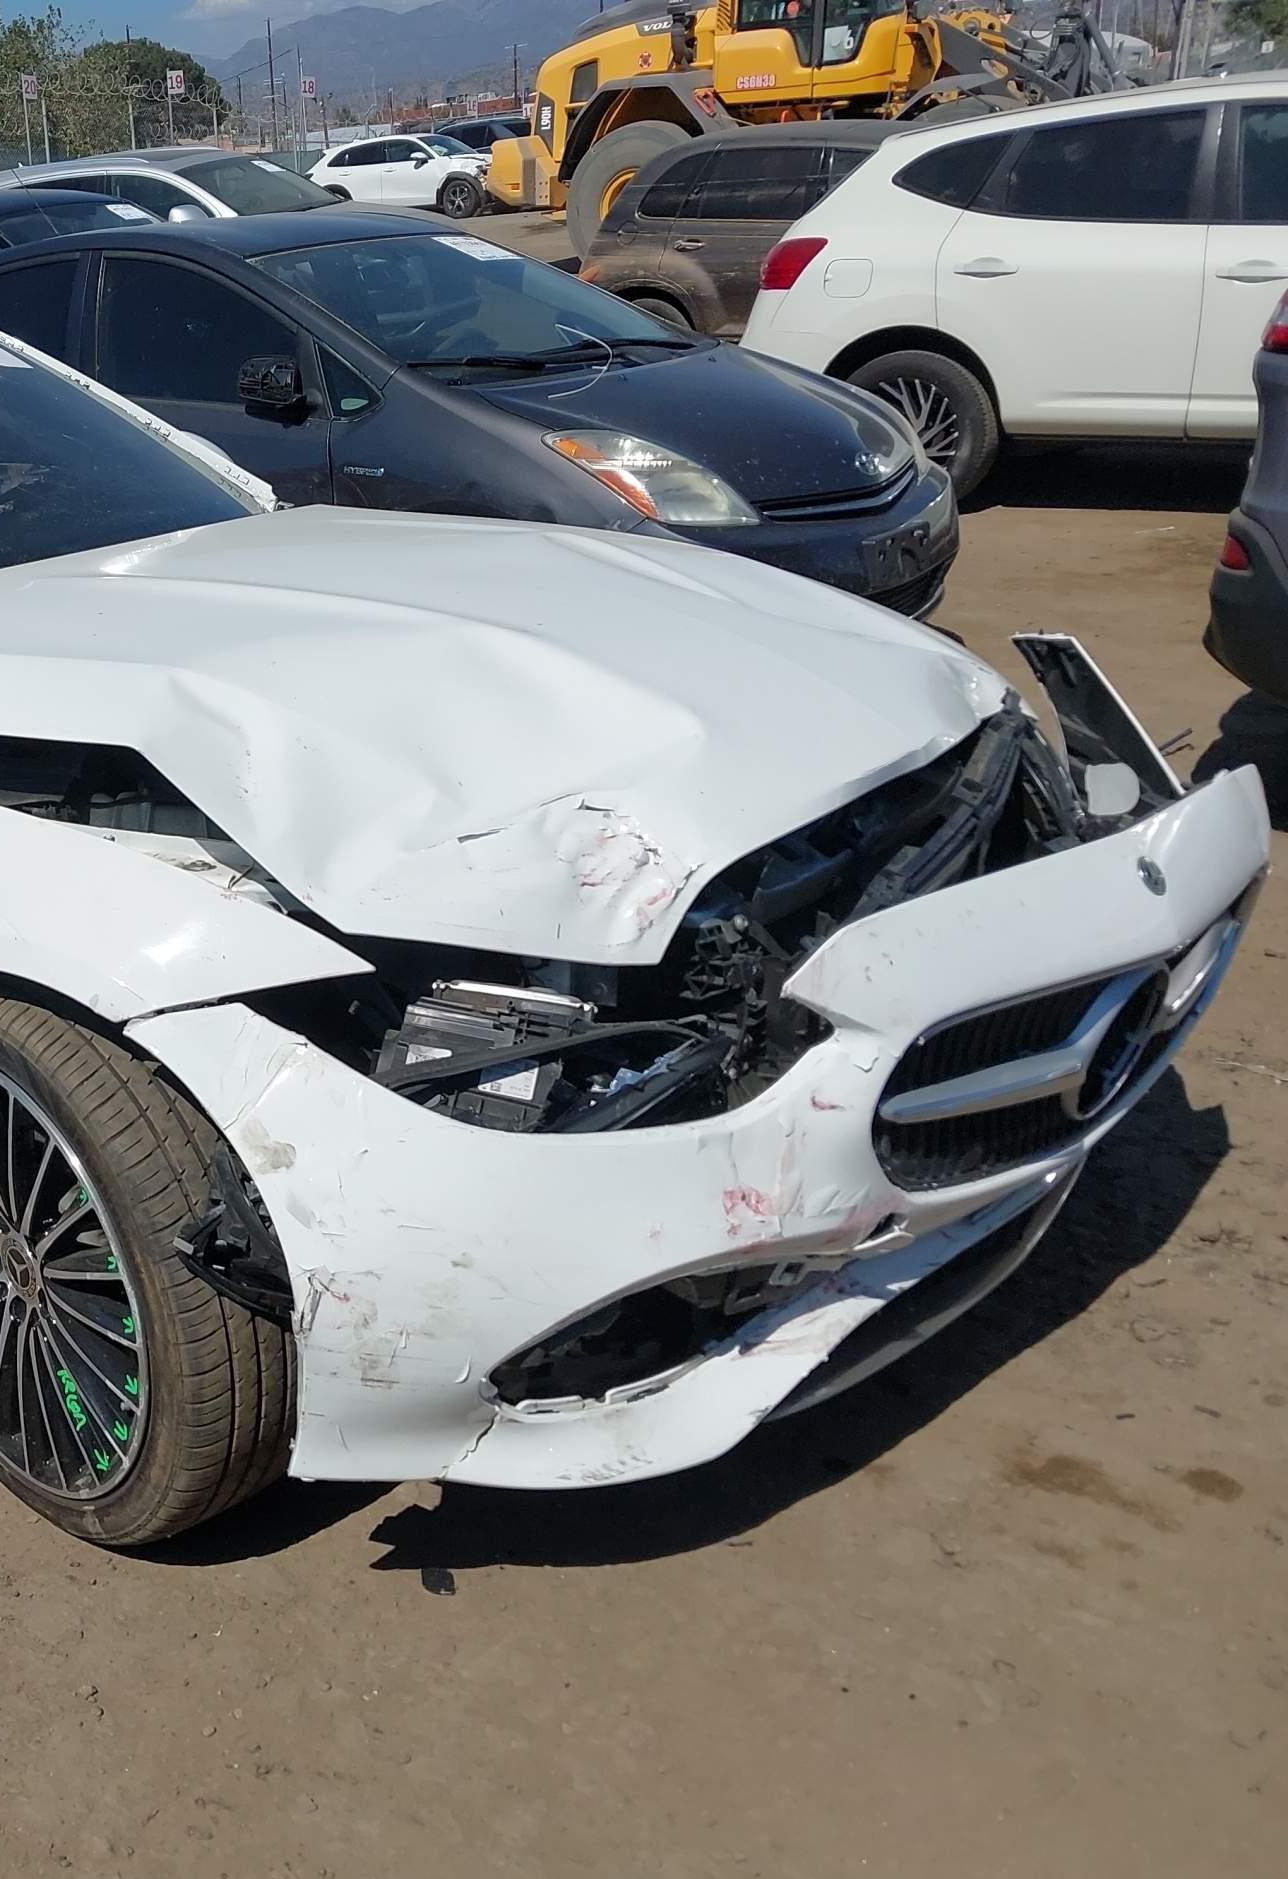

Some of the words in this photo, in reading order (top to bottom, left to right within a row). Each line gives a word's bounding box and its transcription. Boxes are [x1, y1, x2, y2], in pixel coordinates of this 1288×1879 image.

[24, 79, 36, 95] 20
[168, 74, 183, 90] 19
[302, 80, 315, 94] 18
[540, 105, 552, 130] L90H
